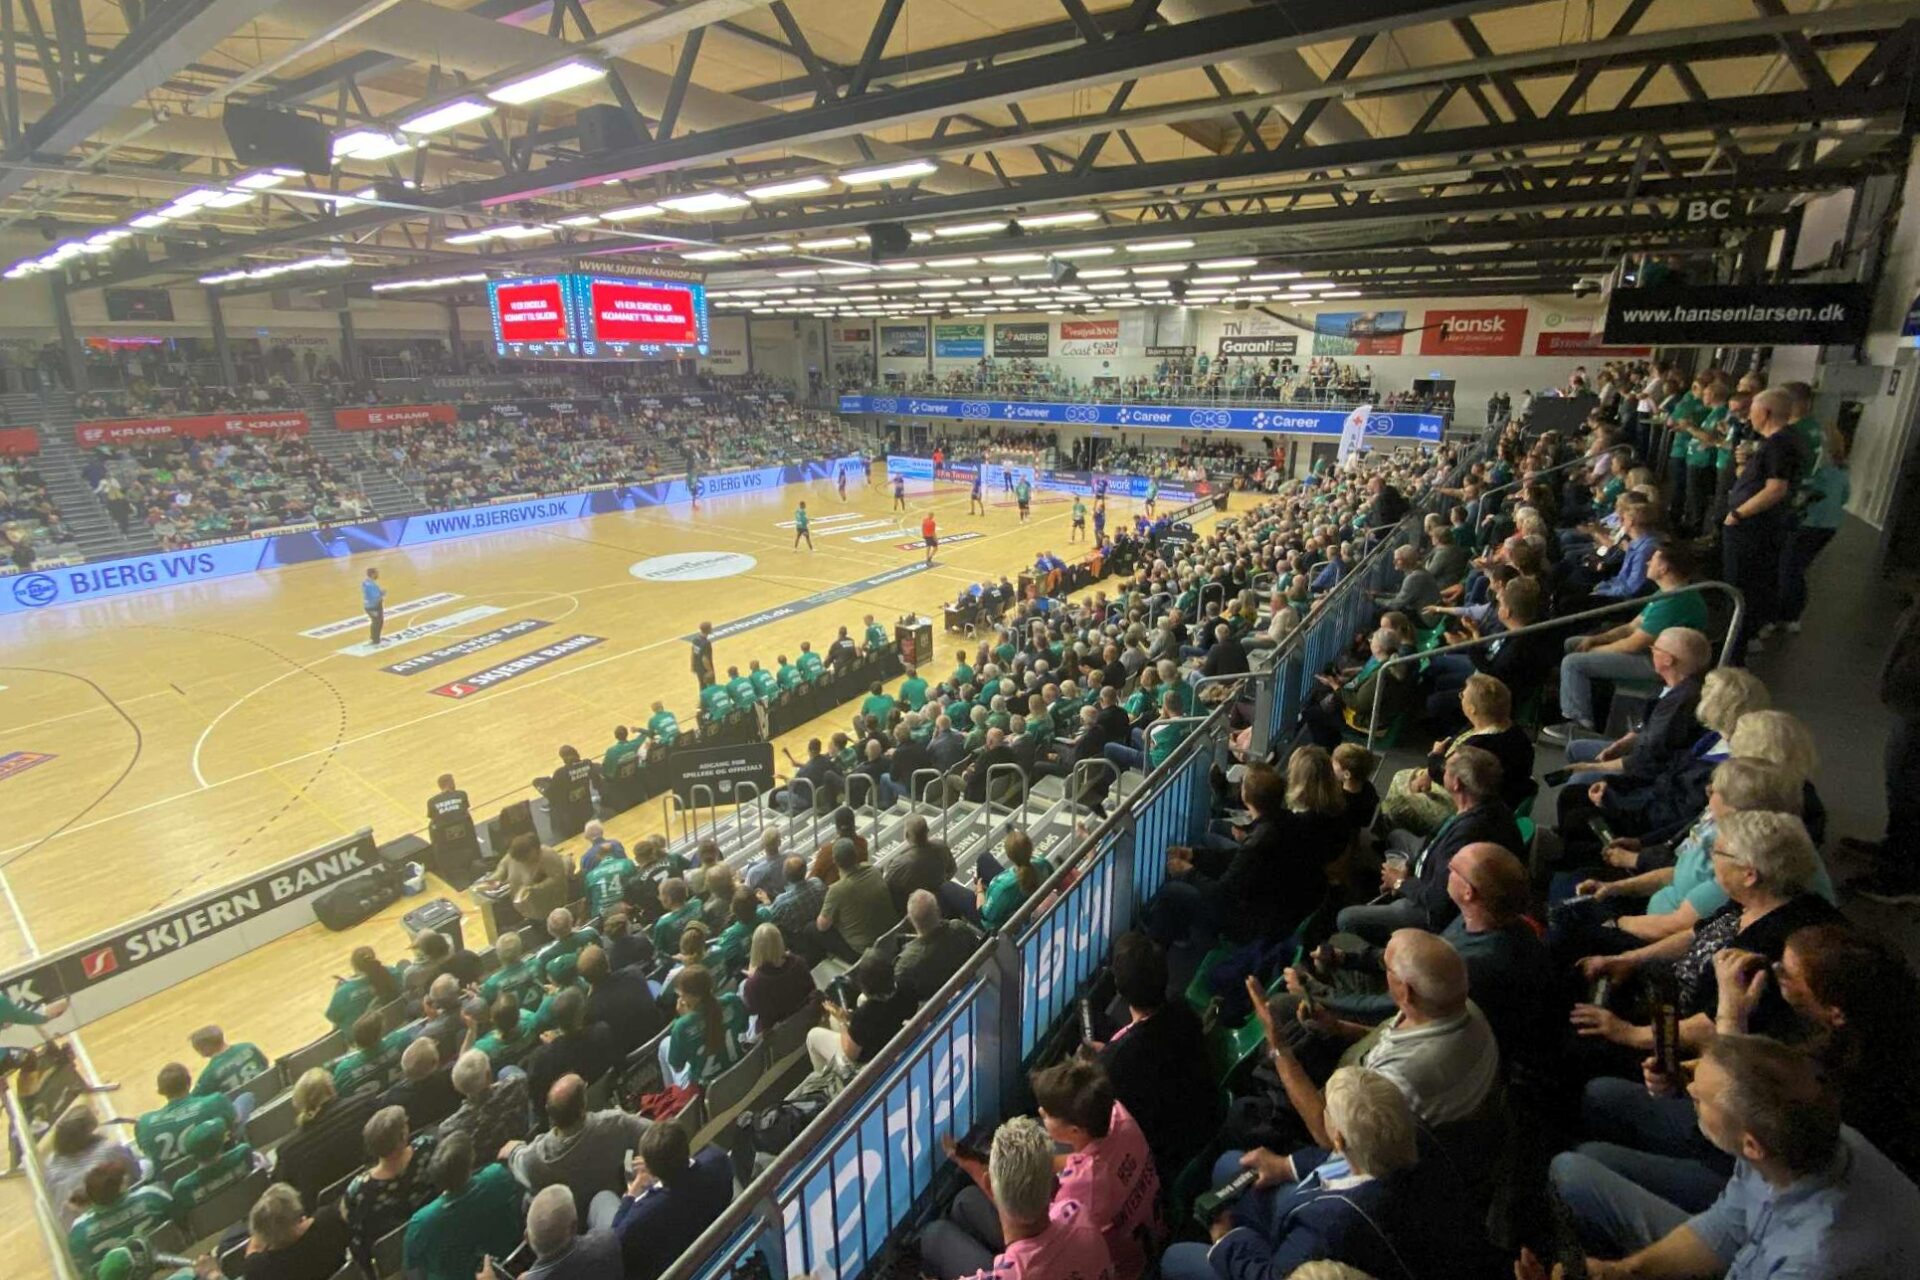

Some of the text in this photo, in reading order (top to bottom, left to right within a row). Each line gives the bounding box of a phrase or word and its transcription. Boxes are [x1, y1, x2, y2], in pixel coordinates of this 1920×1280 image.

[1687, 199, 1731, 222] BC
[1441, 314, 1506, 333] dansk
[1622, 304, 1846, 323] www.hansenlarsen.dk
[1223, 321, 1243, 336] TN
[248, 419, 301, 429] KRAMP
[386, 411, 429, 420] KRAMP
[921, 403, 948, 413] Career
[1017, 406, 1050, 418] Career
[1067, 407, 1097, 421] JKS
[1133, 410, 1173, 423] Career
[1192, 411, 1230, 427] JKS
[1272, 414, 1320, 429] Career
[110, 425, 173, 438] KRAMP
[709, 473, 762, 493] BJERG VVS
[425, 501, 568, 536] WWW.BJERGVVS.DK
[69, 561, 158, 595] BJERG
[161, 553, 215, 579] VVS
[468, 635, 598, 686] SKJERN BANK
[682, 770, 714, 779] SPILLERE
[728, 764, 763, 774] OFFICIALS
[595, 873, 623, 898] 14
[126, 845, 367, 962] SKJERN BANK
